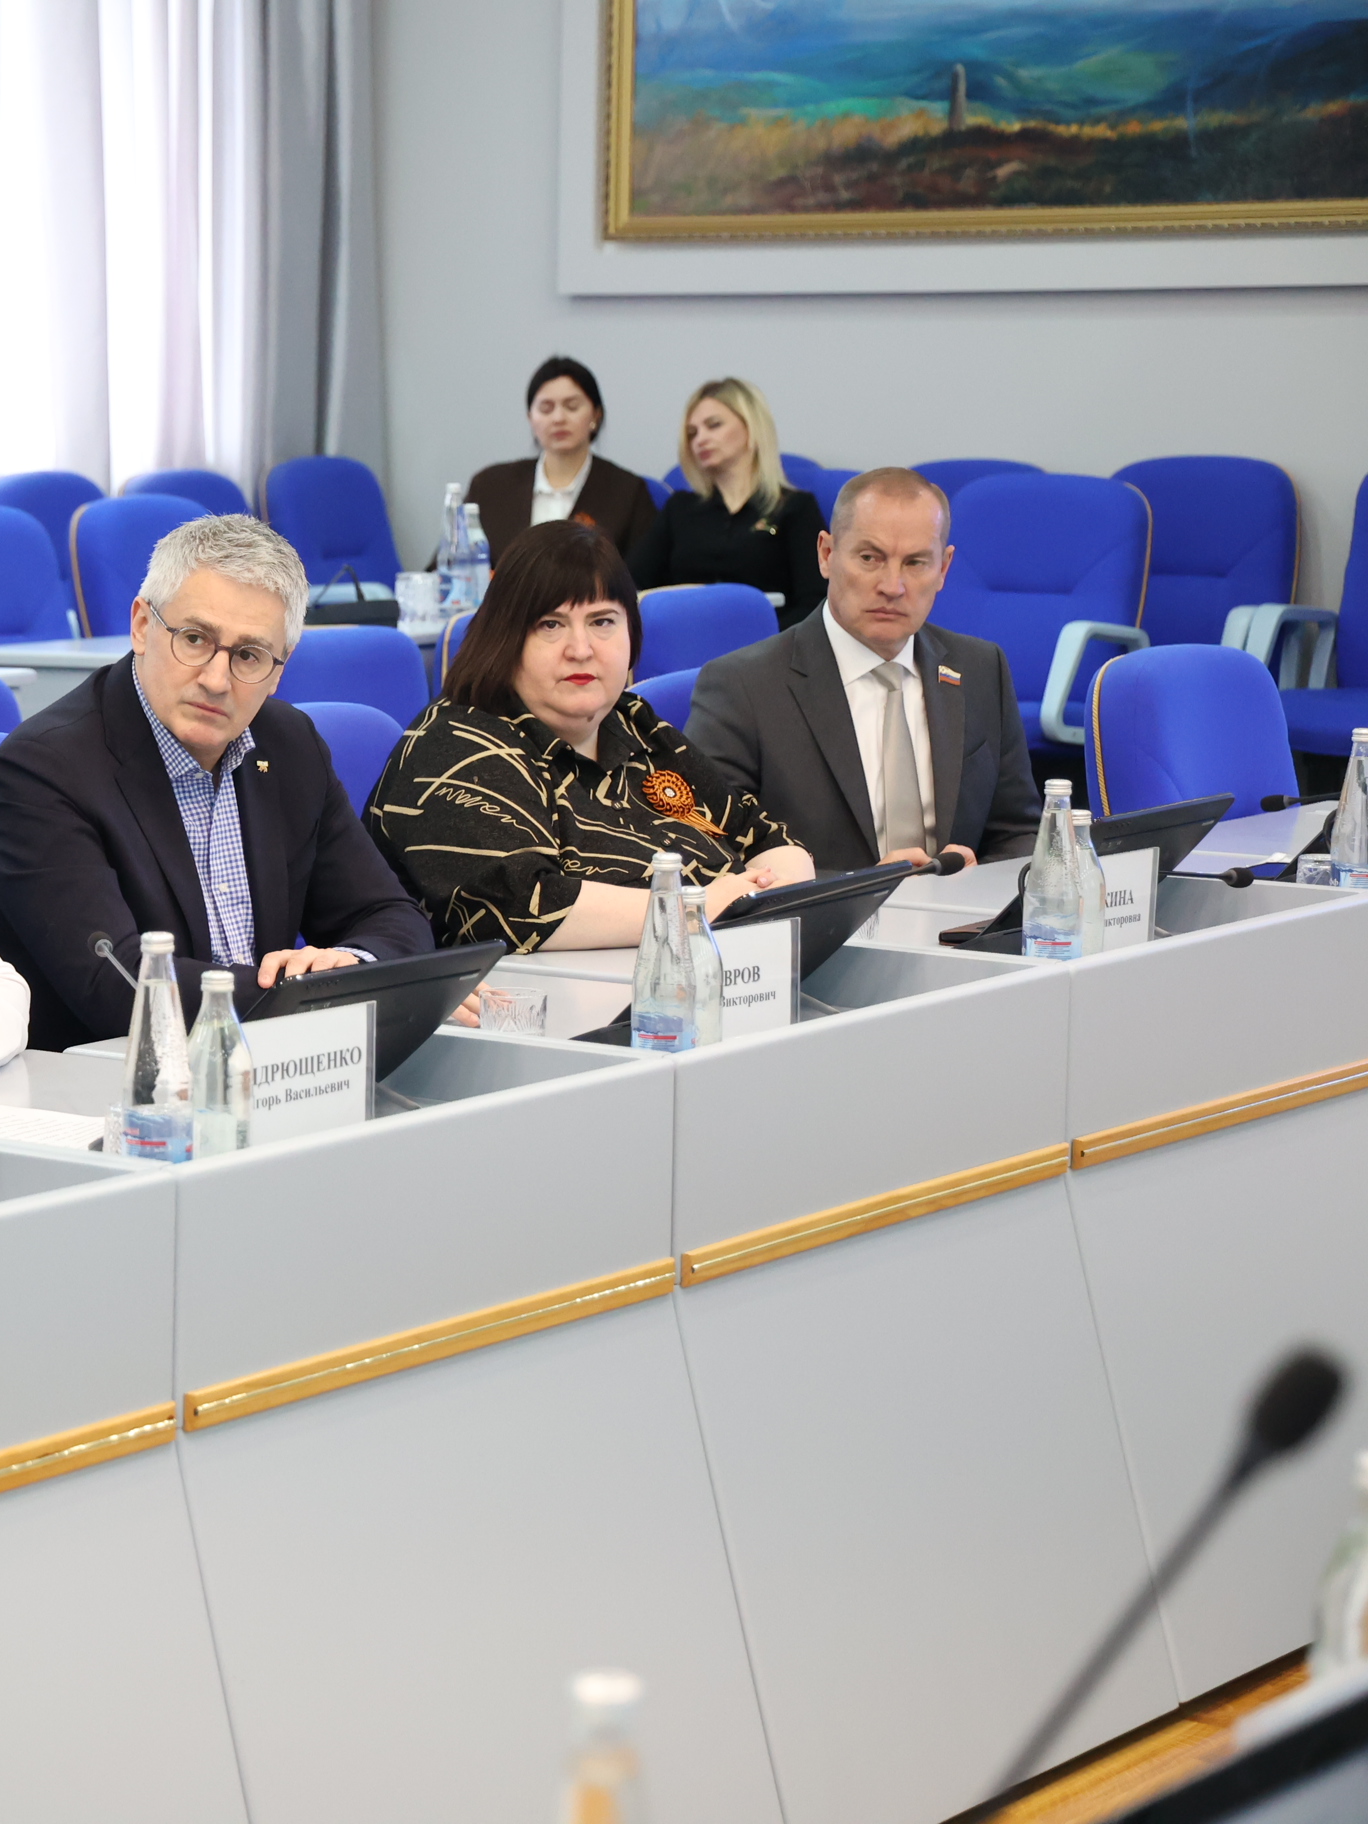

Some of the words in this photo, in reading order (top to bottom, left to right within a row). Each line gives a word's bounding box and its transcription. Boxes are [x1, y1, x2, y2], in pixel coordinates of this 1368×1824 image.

[724, 965, 761, 987] ВРОВ
[253, 1094, 281, 1111] горь
[285, 1079, 350, 1103] Васильевич
